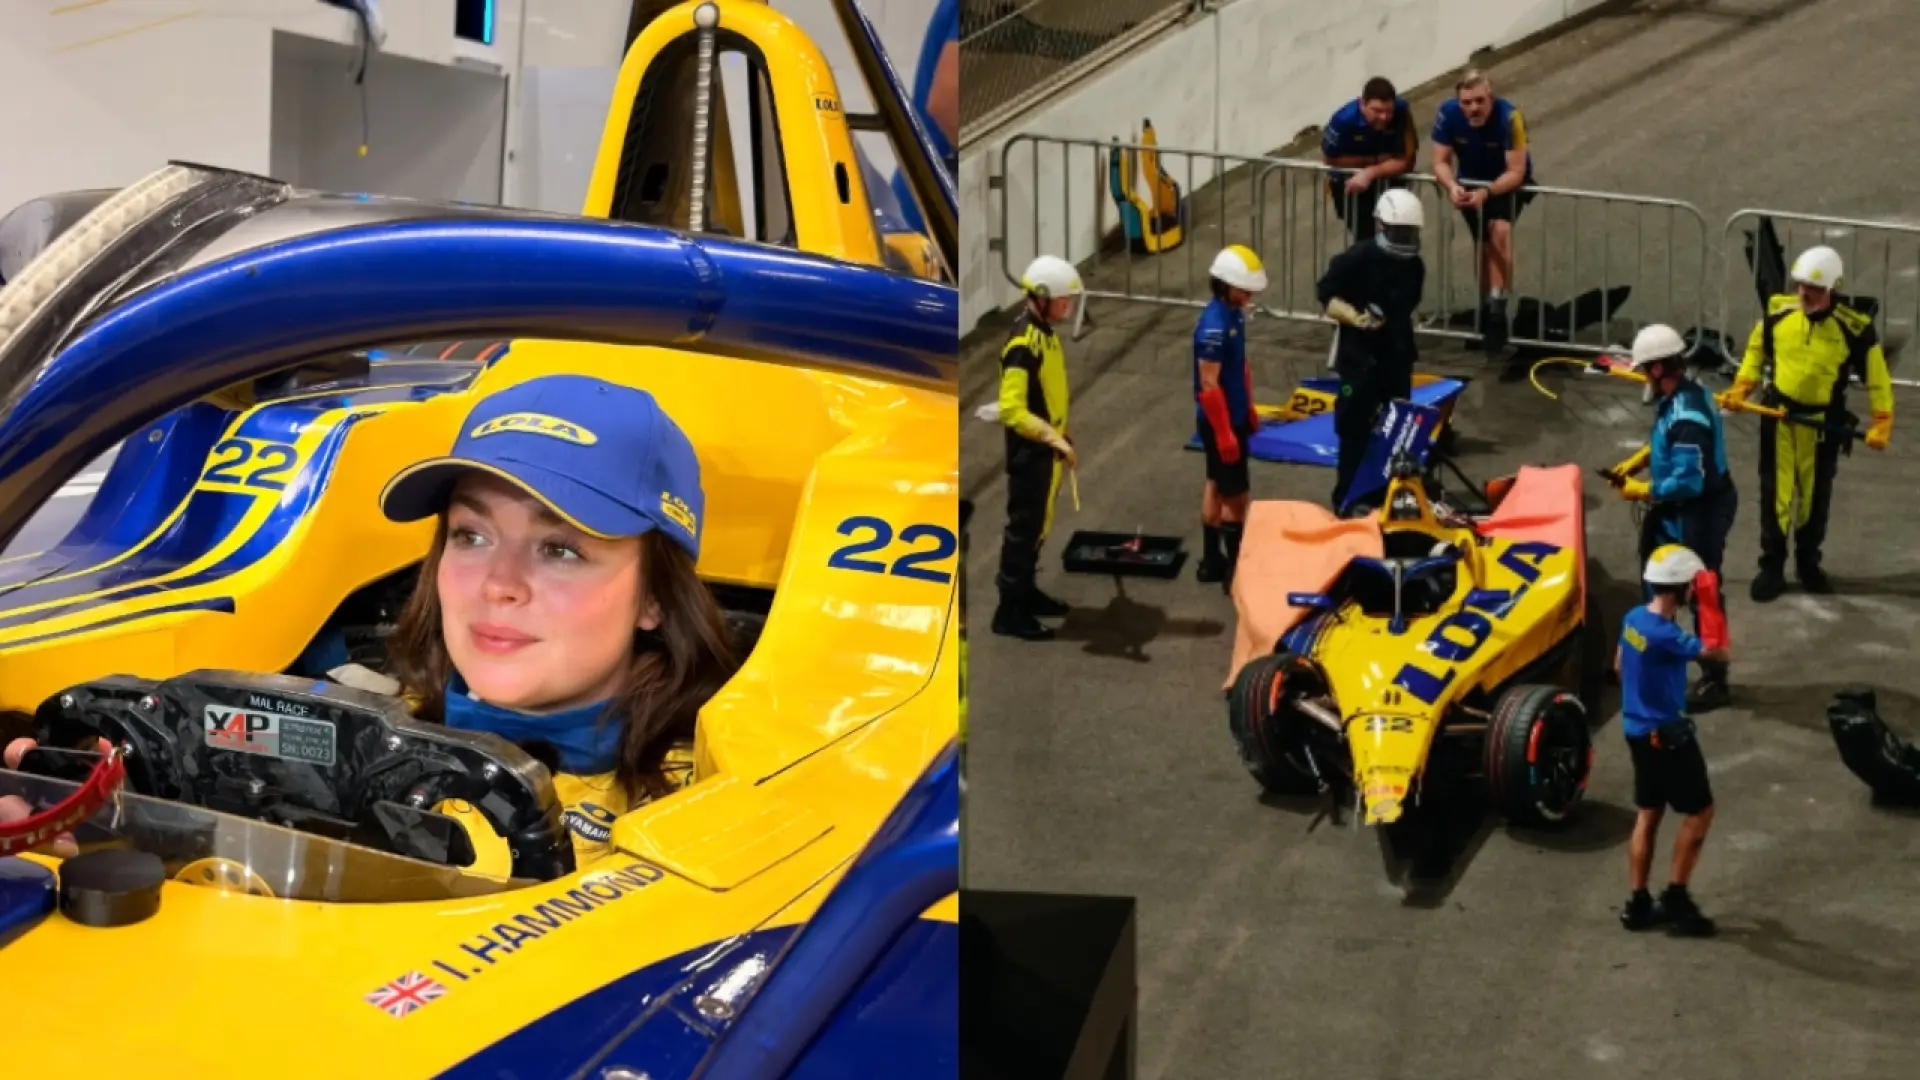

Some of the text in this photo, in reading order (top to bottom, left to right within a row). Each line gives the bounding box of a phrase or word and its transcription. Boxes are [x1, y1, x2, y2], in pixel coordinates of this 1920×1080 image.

[482, 416, 580, 440] LOLA
[1293, 394, 1327, 414] 22
[203, 439, 298, 489] 22
[828, 515, 957, 584] 22
[1392, 541, 1562, 705] LOLA
[250, 695, 309, 716] MAL RACE
[459, 863, 664, 964] HAMMOND
